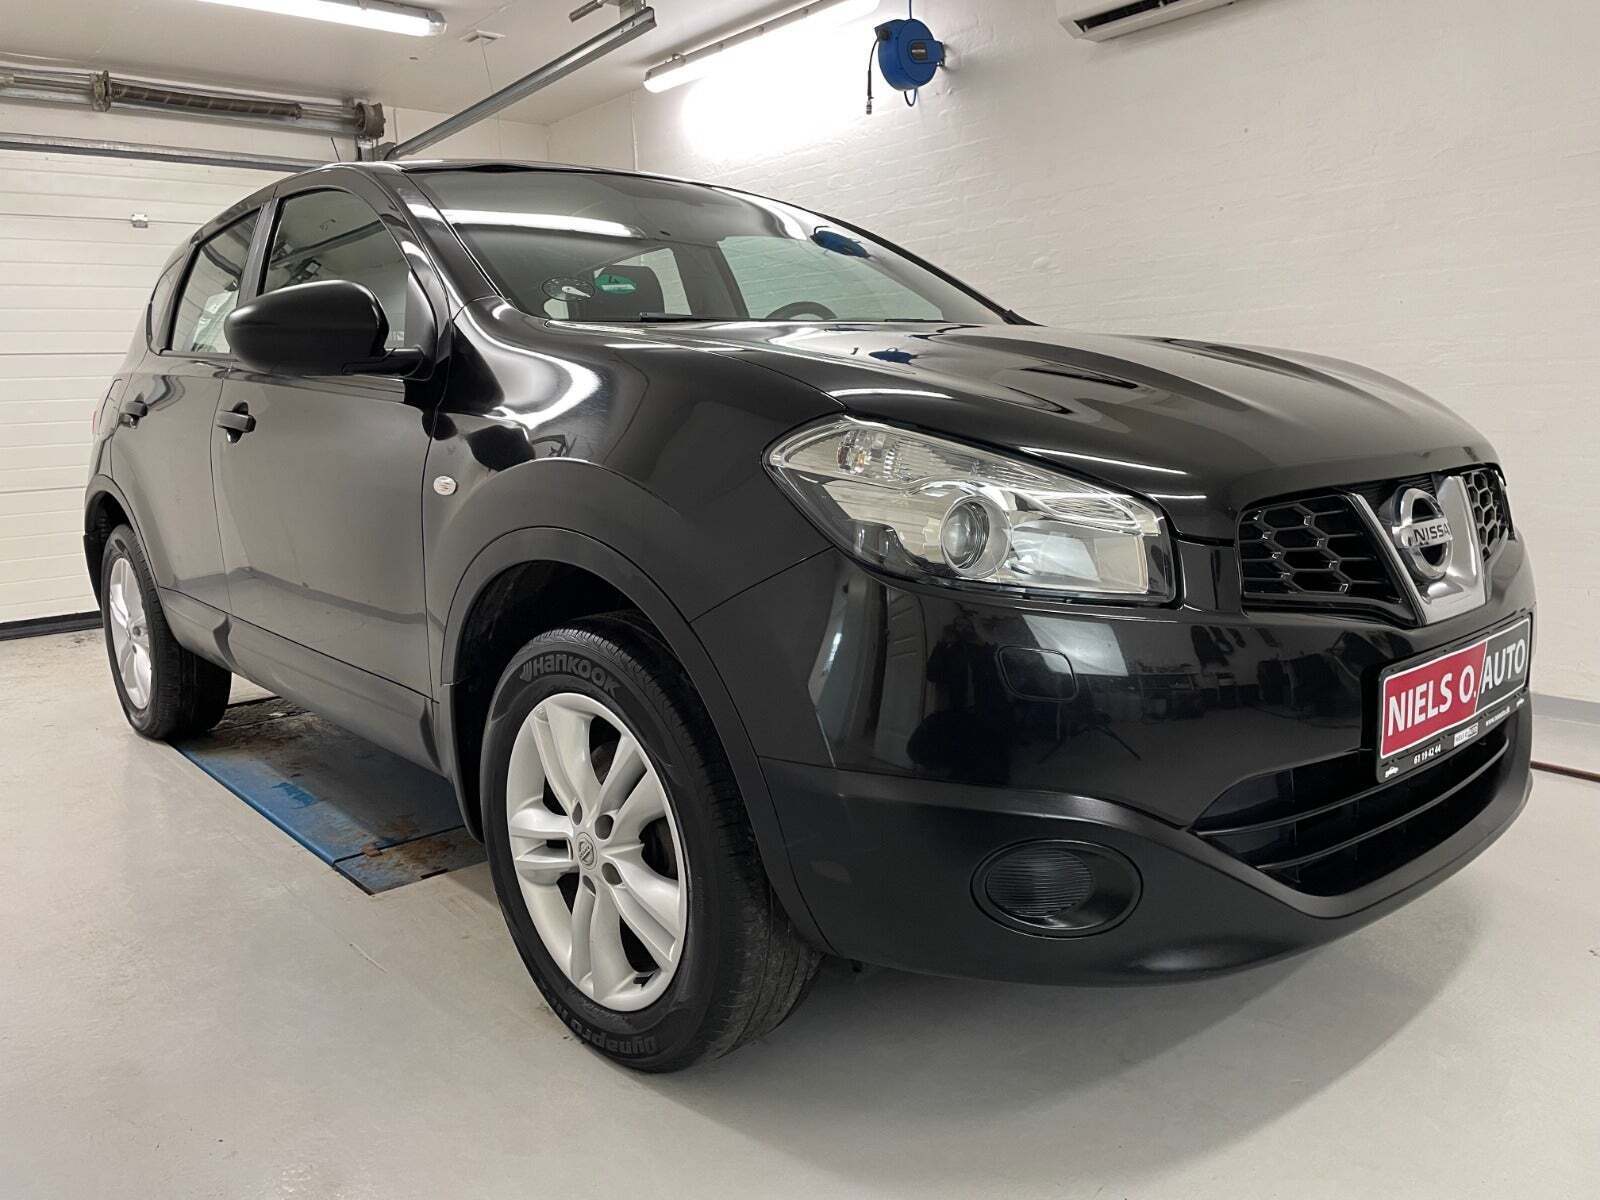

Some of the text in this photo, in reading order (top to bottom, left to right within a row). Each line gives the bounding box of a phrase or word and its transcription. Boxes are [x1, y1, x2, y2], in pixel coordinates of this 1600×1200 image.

[1387, 673, 1453, 737] NIELS
[1459, 665, 1477, 704] O.
[1481, 638, 1526, 694] AUTO
